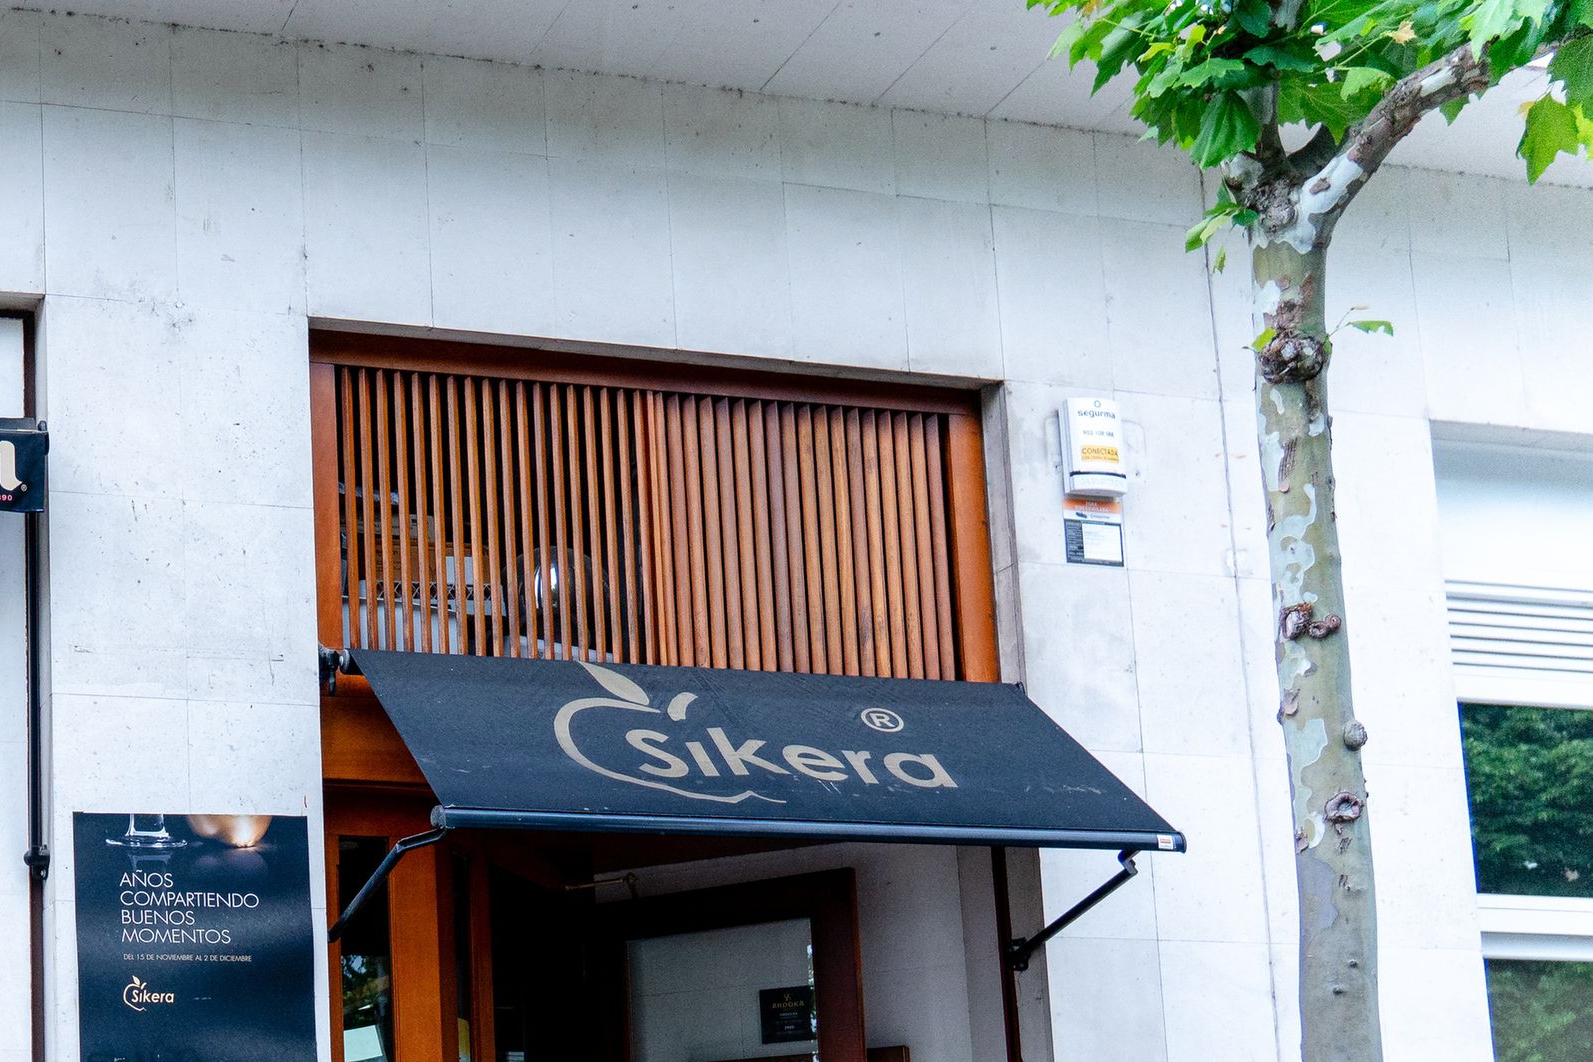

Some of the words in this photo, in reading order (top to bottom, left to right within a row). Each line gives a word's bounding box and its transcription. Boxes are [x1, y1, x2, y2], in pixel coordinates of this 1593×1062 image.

[1077, 410, 1115, 419] segurma
[625, 725, 958, 789] Sikera
[119, 869, 174, 888] AÑOS
[120, 890, 260, 908] COMPARTIENDO
[121, 909, 195, 925] BUENOS
[121, 928, 231, 944] MOMENTOS
[123, 953, 135, 961] DEL
[136, 953, 145, 961] 15
[146, 953, 155, 961] DE
[156, 954, 194, 962] NOVIEMBRE
[194, 954, 202, 962] AL
[204, 954, 208, 962] 2
[209, 954, 219, 962] DE
[219, 955, 253, 963] DICIEMBRE
[131, 989, 175, 1003] Sikera
